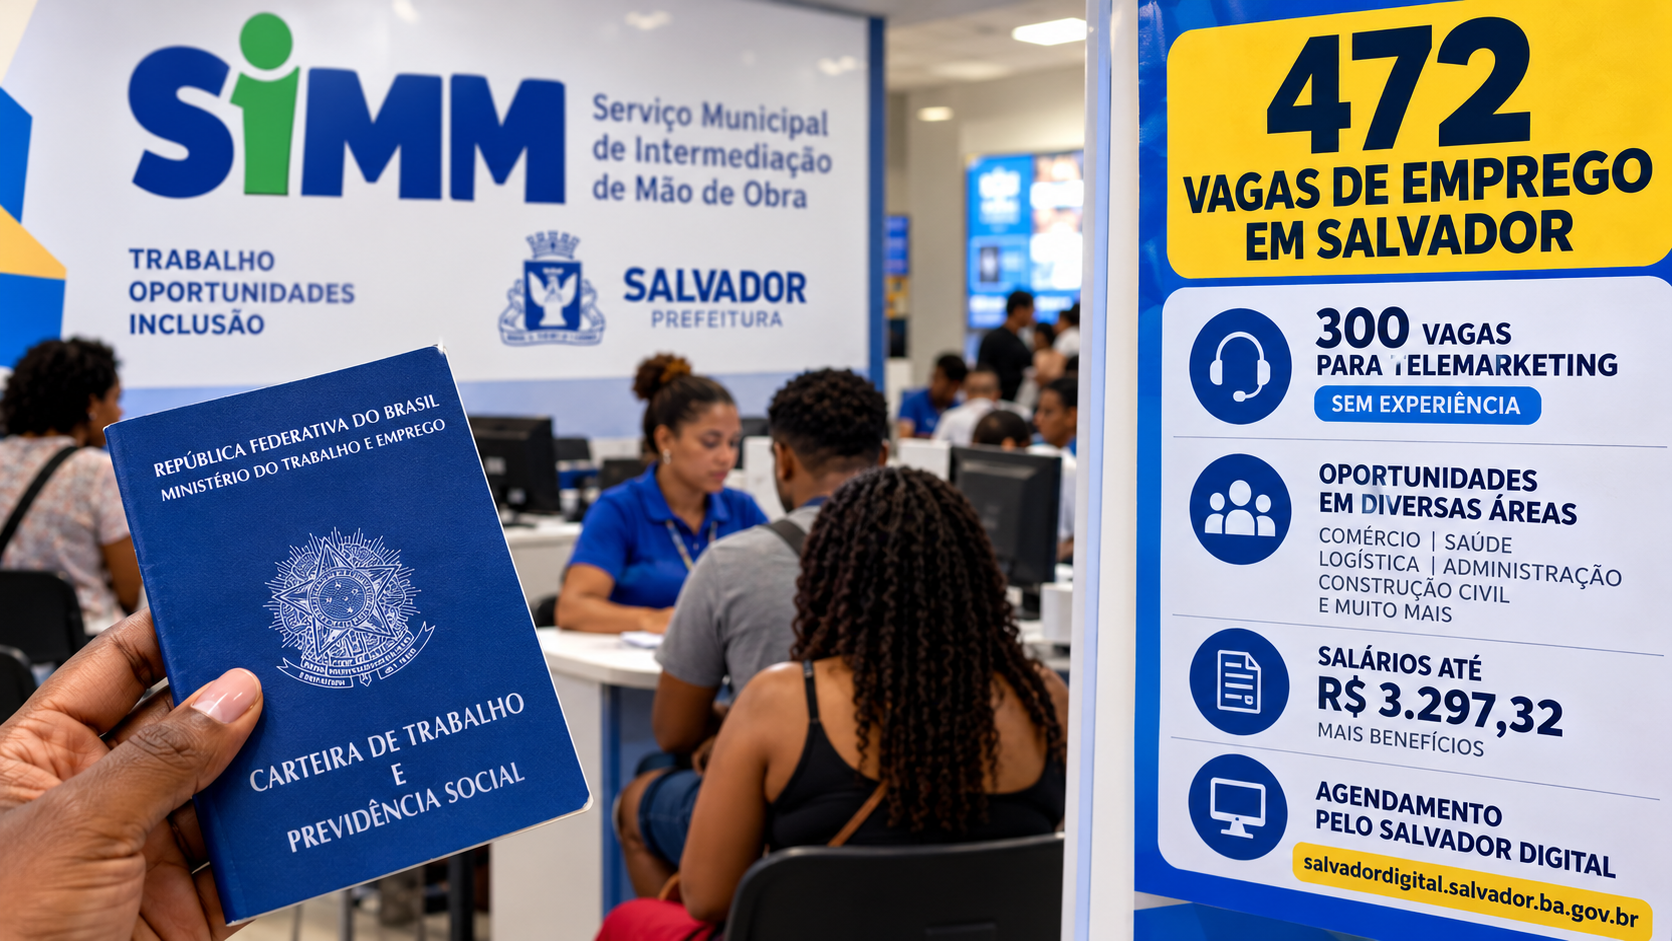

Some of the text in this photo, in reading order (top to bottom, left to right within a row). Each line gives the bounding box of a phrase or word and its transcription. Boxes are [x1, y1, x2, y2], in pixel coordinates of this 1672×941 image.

[1267, 16, 1531, 154] 472
[129, 12, 566, 204] SiMM
[592, 93, 828, 139] Serviço Municipal
[592, 135, 831, 176] de Intermediação
[592, 174, 807, 208] de Mão de Obra
[1183, 147, 1653, 213] VAGAS DE EMPREGO
[1246, 210, 1574, 261] EM SALVADOR
[129, 249, 275, 272] TRABALHO
[129, 280, 355, 303] OPORTUNIDADES
[623, 267, 807, 303] SALVADOR
[129, 310, 265, 335] INCLUSÃO
[652, 310, 783, 328] PREFEITURA
[1316, 306, 1511, 349] 300 VAGAS
[1317, 355, 1383, 376] PARA
[1332, 391, 1520, 415] SEM EXPERIÊNCIA
[154, 394, 440, 478] REPÚBLICA FEDERATIVA DO BRASIL
[161, 419, 446, 502] MINISTÉRIO DO TRABALHO E EMPREGO
[1319, 463, 1538, 492] OPORTUNIDADES
[1320, 492, 1578, 525] EM DIVERSAS ÁREAS
[1319, 526, 1512, 554] COMÉRCIO SAÚDE
[1319, 549, 1622, 589] LOGÍSTICA ADMINISTRAÇÃO
[1318, 574, 1510, 603] CONSTRUÇÃO CIVIL
[1319, 597, 1453, 622] E MUITO MAIS
[1318, 645, 1482, 681] SALÁRIOS ATÉ
[1318, 676, 1564, 738] R$ 3.297,32
[249, 692, 525, 792] CARTEIRA DE TRABALHO
[1318, 722, 1484, 757] MAIS BENEFÍCIOS
[391, 763, 406, 786] E
[287, 761, 525, 853] PREVIDÊNCIA SOCIAL
[1316, 781, 1502, 827] AGENDAMENTO
[1316, 809, 1616, 878] PELO SALVADOR DIGITAL
[1304, 854, 1638, 928] salvadordigital.salvador.ba.gov.br
